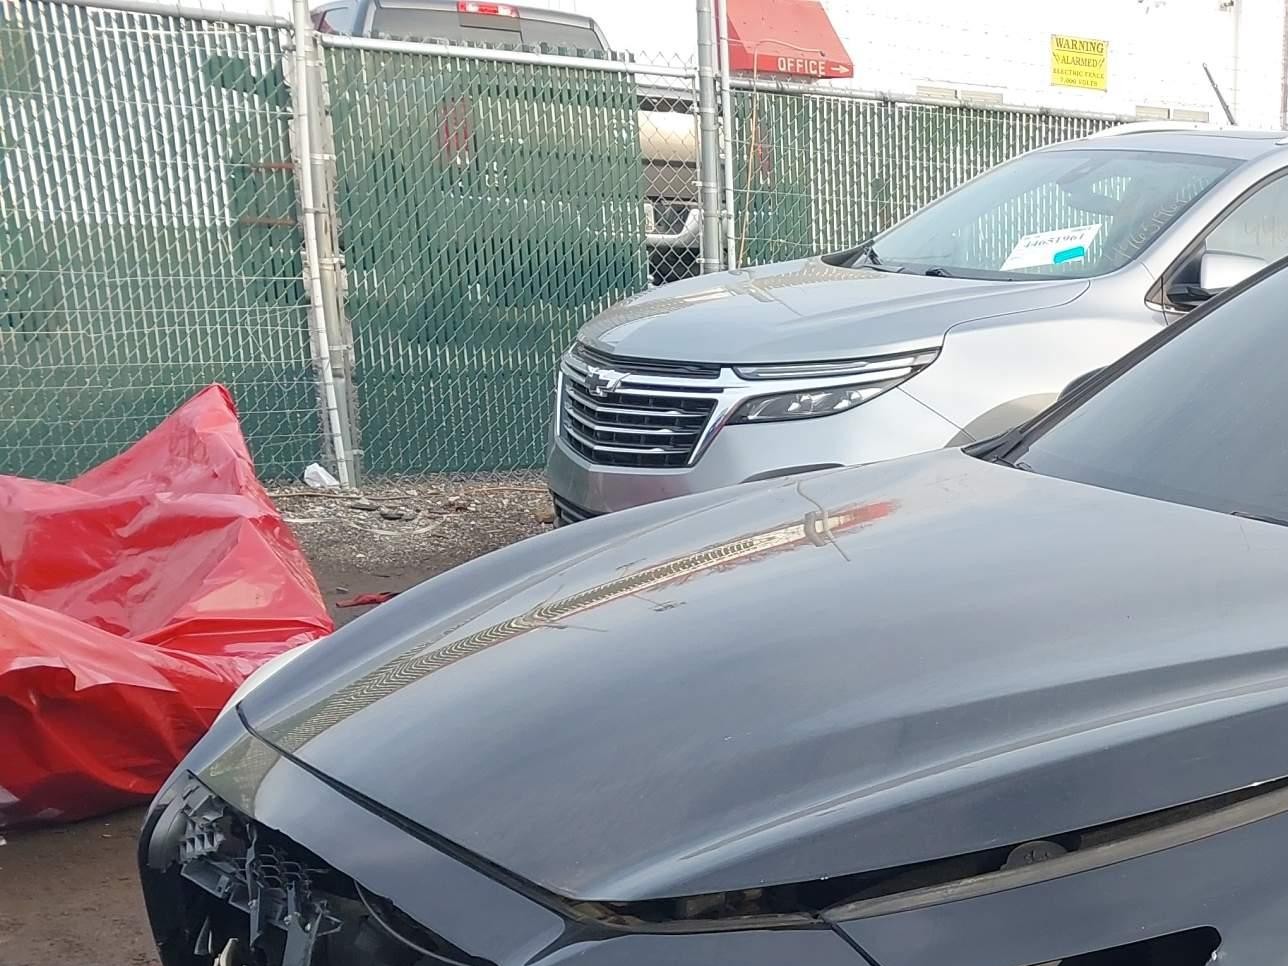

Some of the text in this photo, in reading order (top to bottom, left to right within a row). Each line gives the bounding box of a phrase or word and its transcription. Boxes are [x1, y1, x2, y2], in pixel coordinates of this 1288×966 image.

[1055, 37, 1104, 53] WARNING
[777, 57, 826, 76] OFFICE
[1060, 55, 1098, 67] ALARMED
